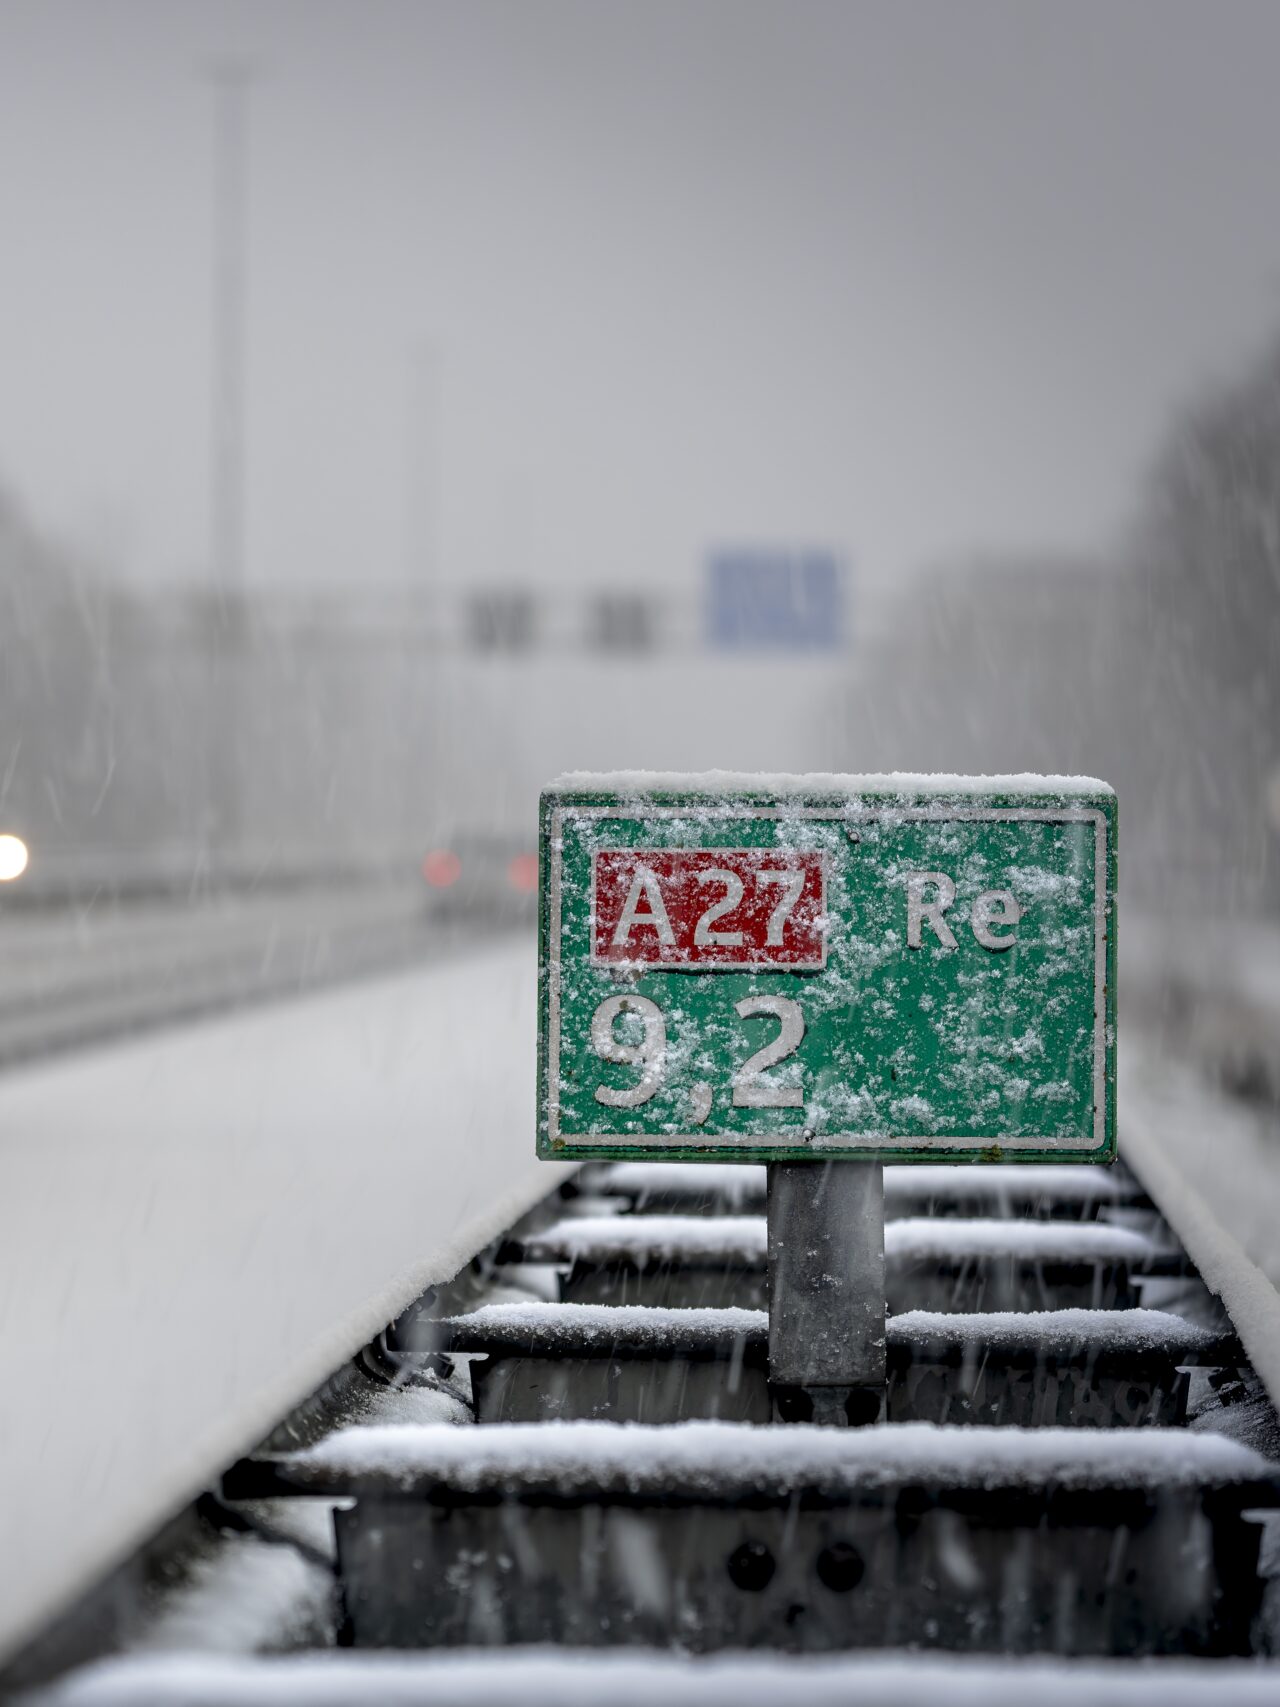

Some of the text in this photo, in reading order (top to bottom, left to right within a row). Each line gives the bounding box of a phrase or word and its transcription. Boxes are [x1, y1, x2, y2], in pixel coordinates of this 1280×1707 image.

[611, 867, 1021, 951] A27 Re
[591, 995, 806, 1125] 9,2
